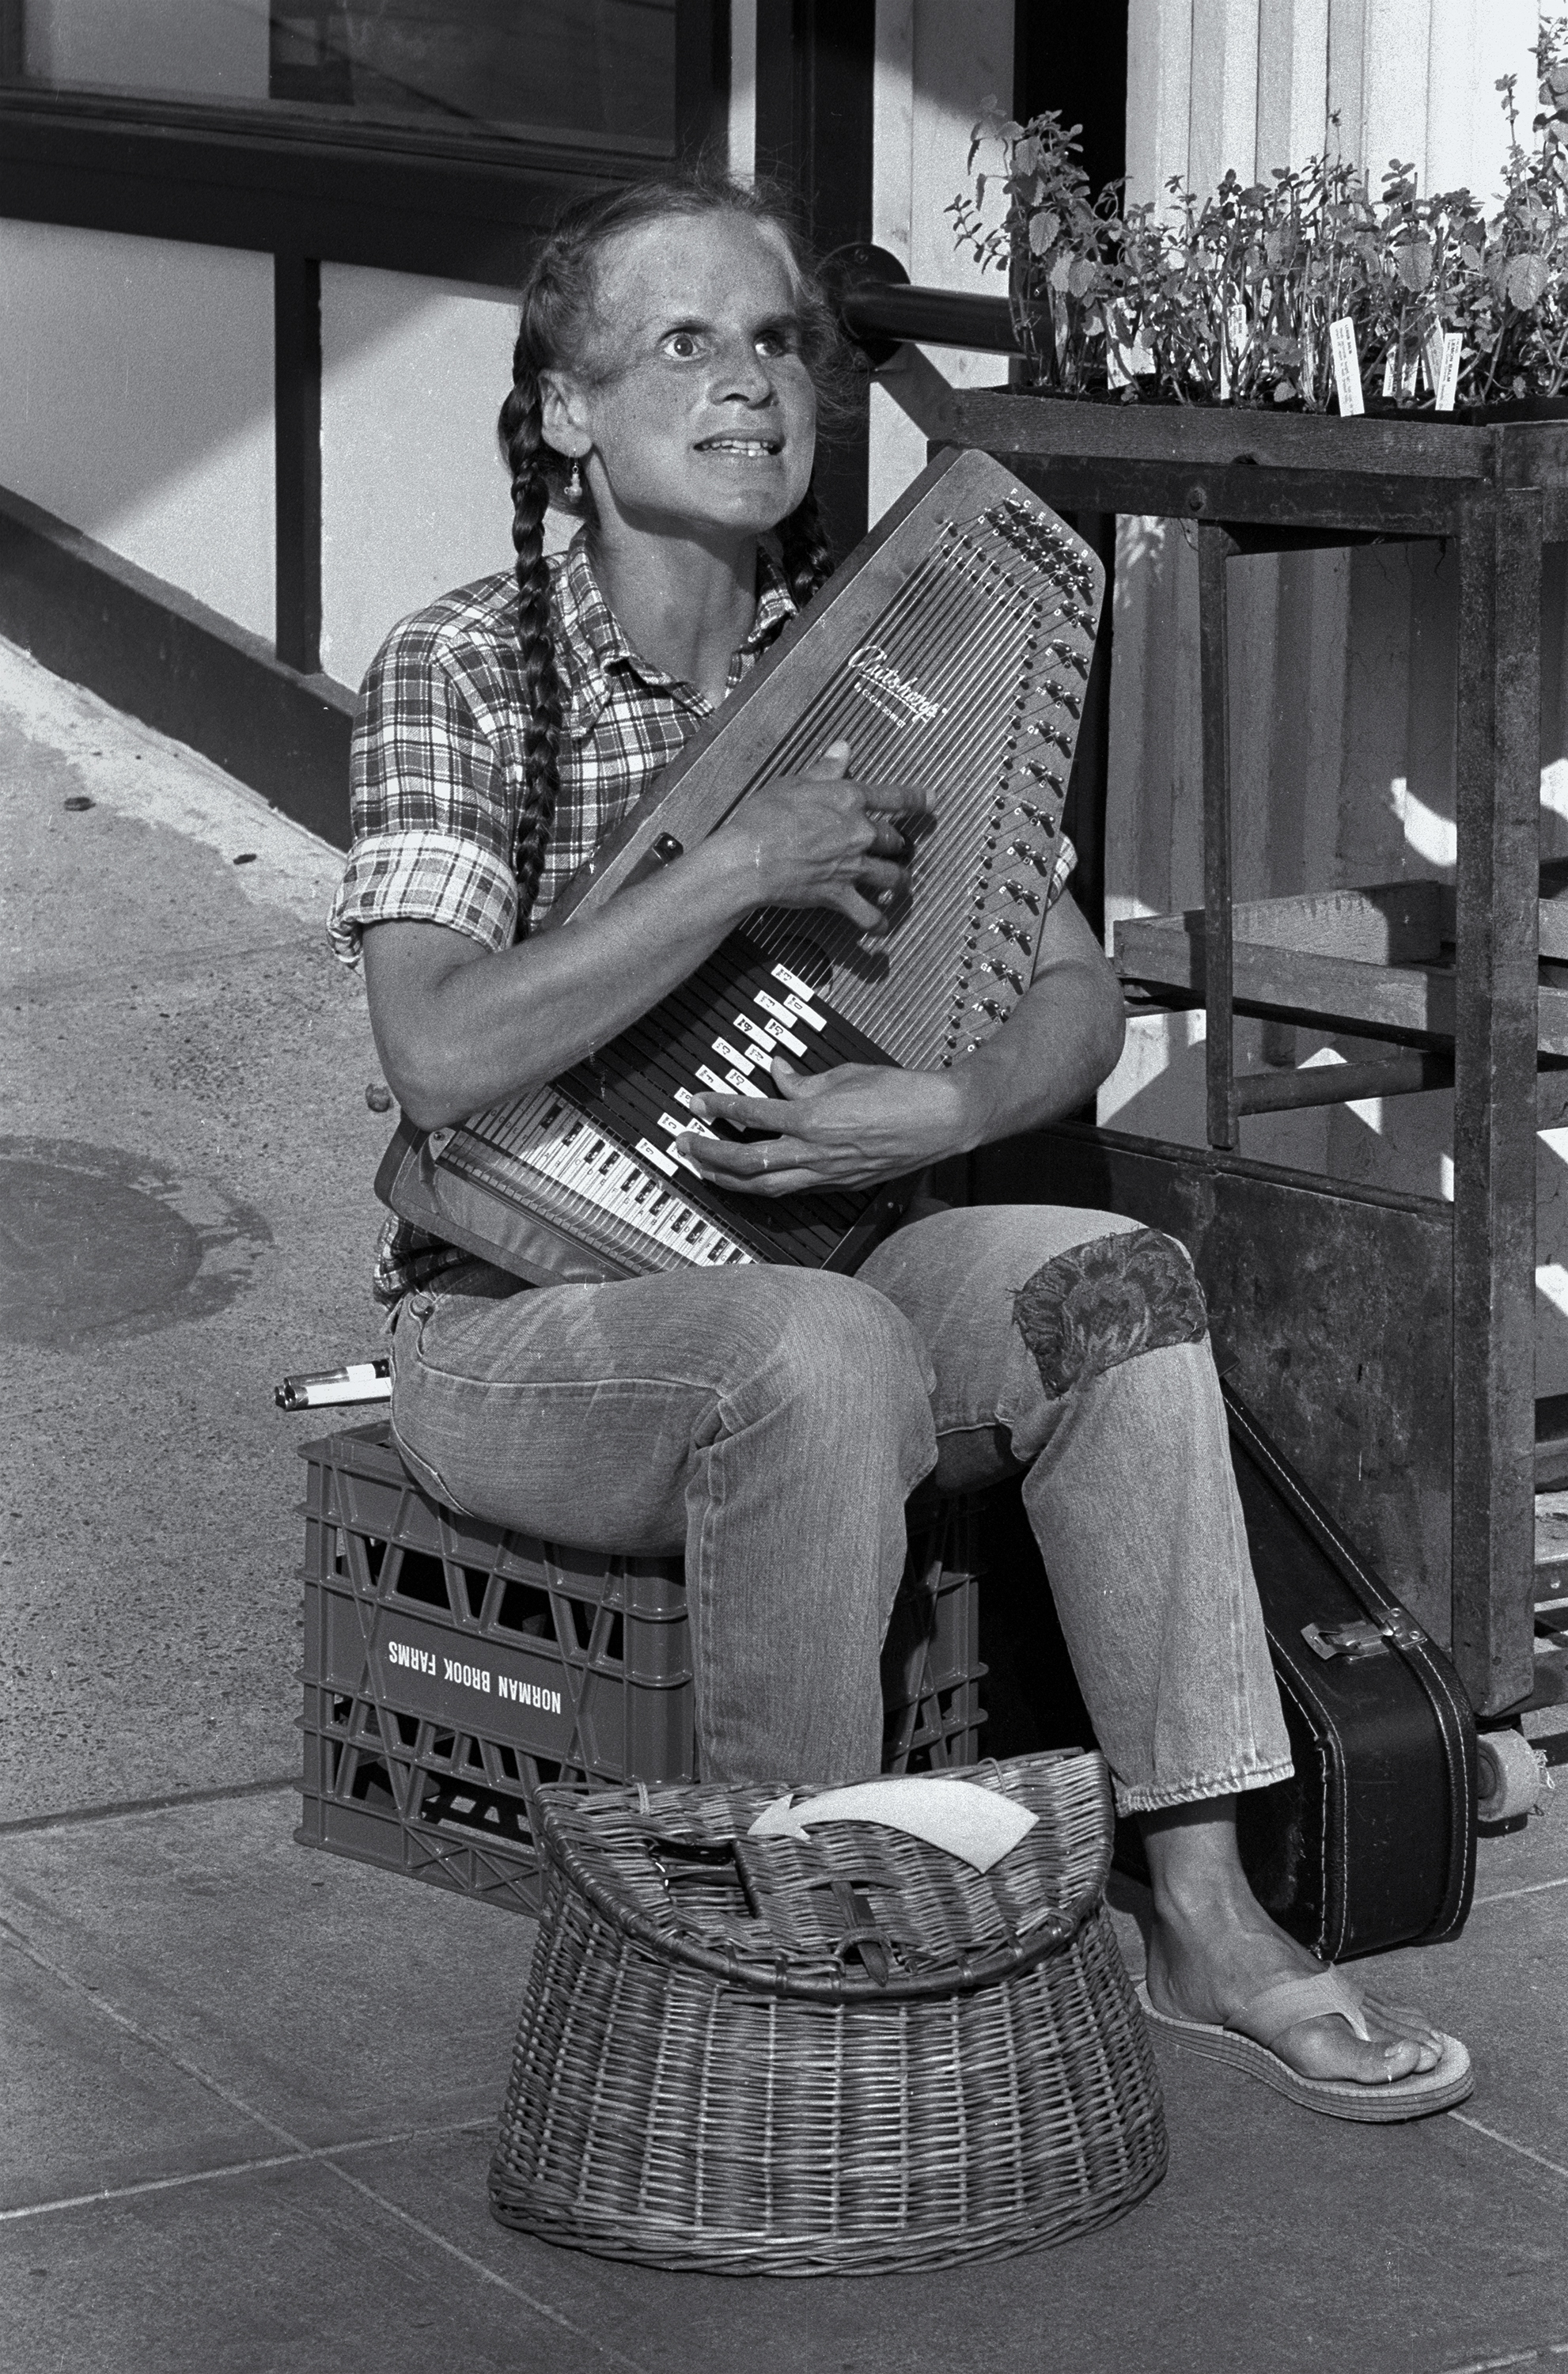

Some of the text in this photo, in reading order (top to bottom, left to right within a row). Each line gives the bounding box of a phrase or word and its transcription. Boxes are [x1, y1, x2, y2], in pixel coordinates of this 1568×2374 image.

[1038, 512, 1046, 521] E
[1045, 647, 1053, 656] E
[706, 1074, 713, 1083] F
[388, 1641, 561, 1714] NORMAN BROOK FARMS
